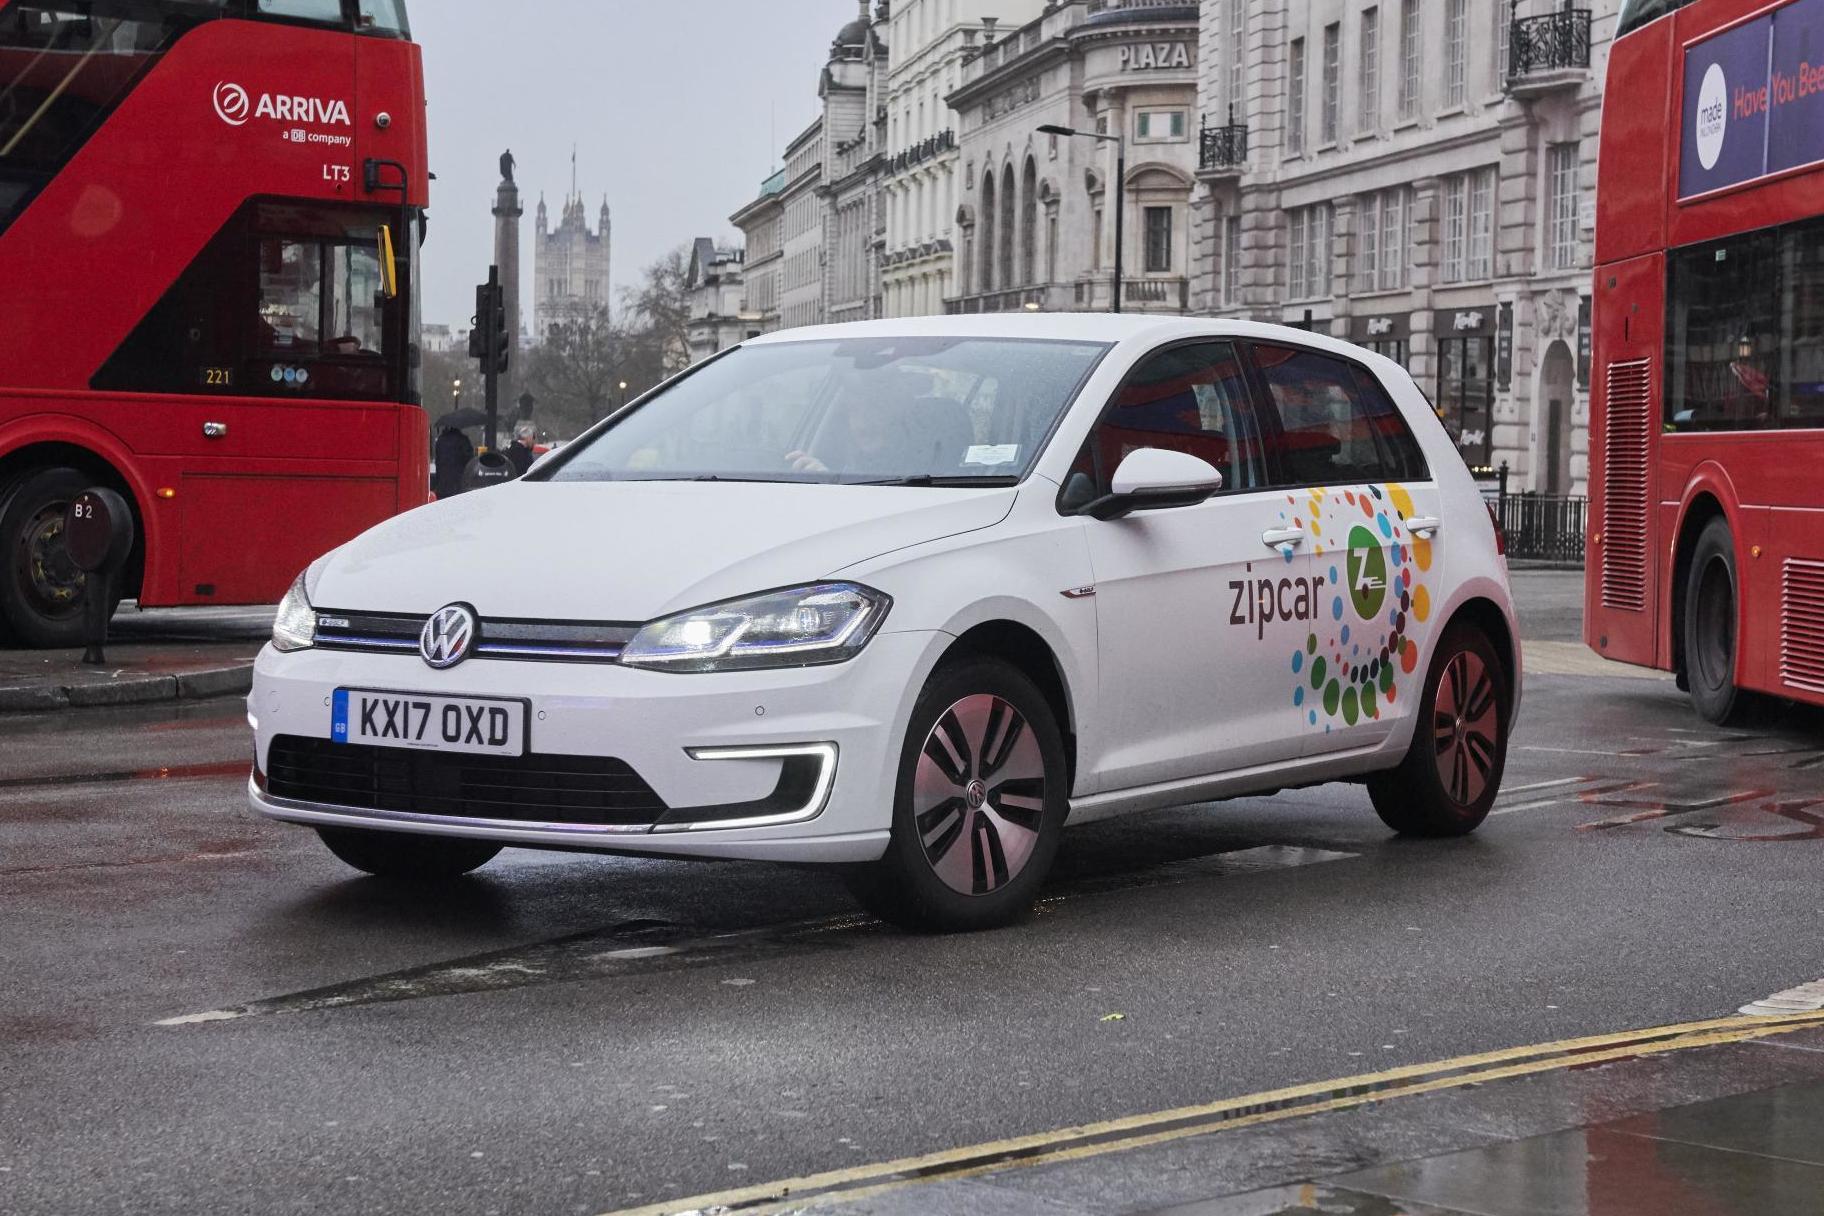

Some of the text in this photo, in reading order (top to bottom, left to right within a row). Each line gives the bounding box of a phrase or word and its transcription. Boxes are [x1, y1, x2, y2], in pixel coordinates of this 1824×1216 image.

[1119, 43, 1189, 71] PLAZA
[254, 93, 351, 126] ARRIVA
[1734, 84, 1769, 121] Have
[1771, 71, 1796, 106] You
[1700, 97, 1722, 125] made
[282, 128, 352, 148] a DB company
[323, 163, 350, 182] LT3
[206, 368, 230, 385] 221
[1229, 562, 1325, 641] zipcar
[335, 722, 346, 734] GB
[361, 697, 509, 747] KX17 OXD
